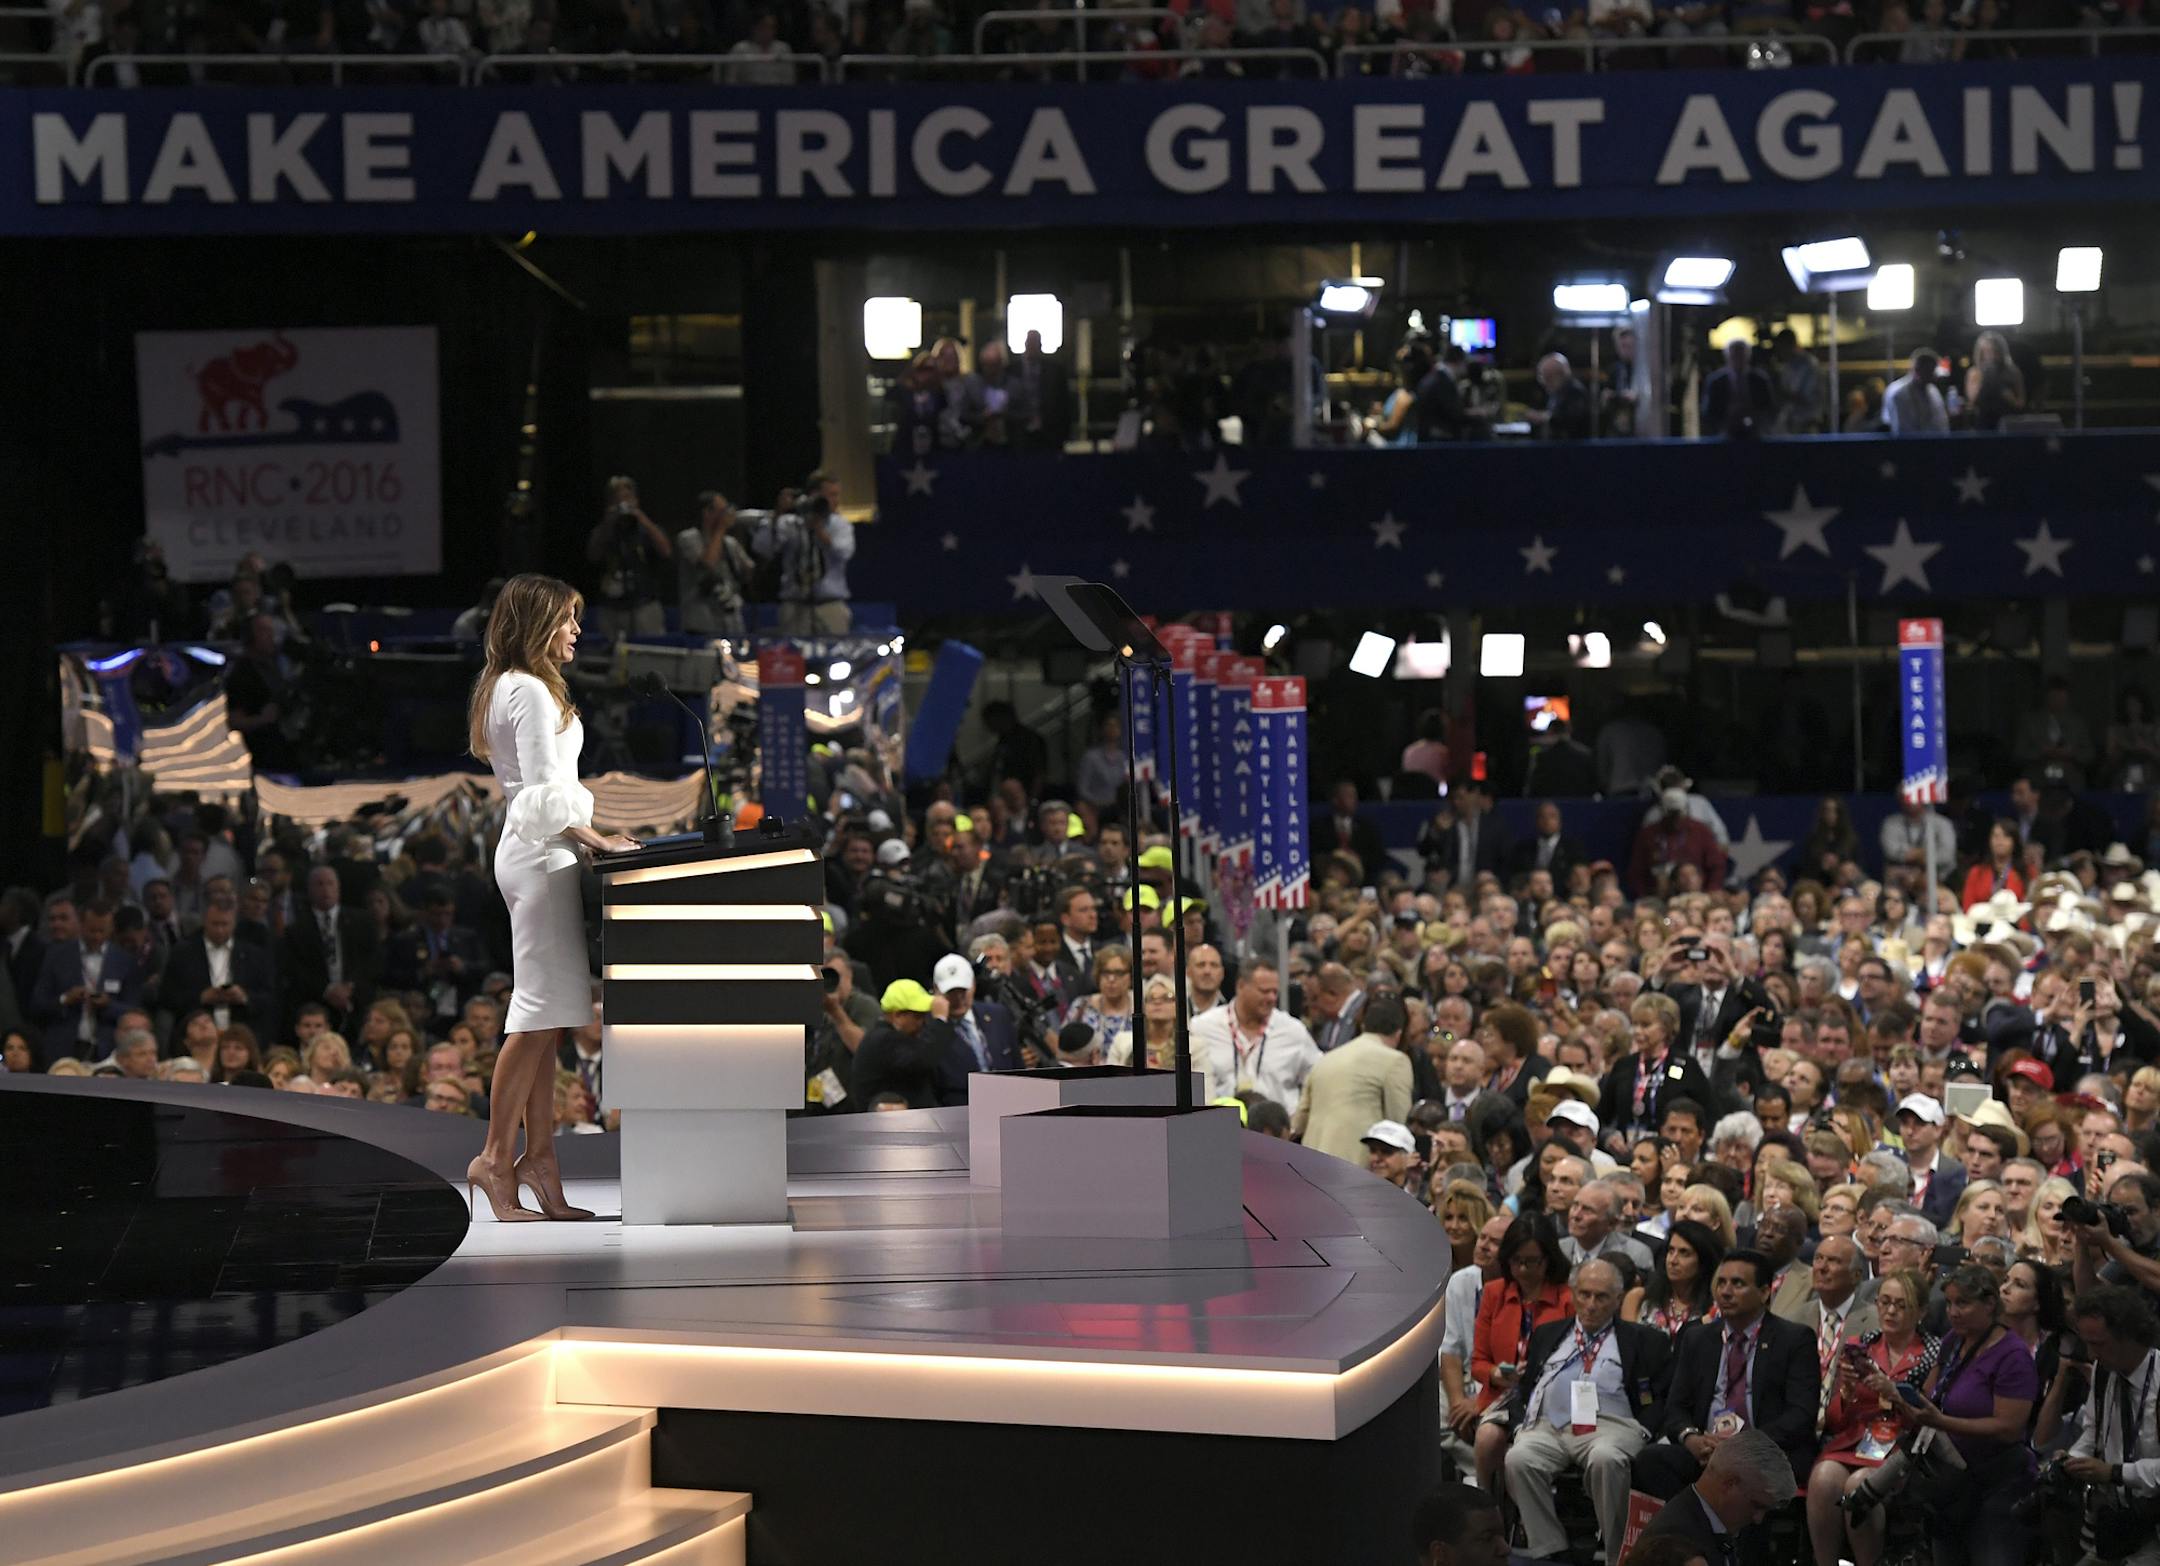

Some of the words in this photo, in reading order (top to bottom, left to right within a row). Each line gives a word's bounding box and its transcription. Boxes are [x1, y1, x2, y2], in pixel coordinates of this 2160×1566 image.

[32, 112, 416, 204] MAKE
[470, 107, 1096, 202] AMERICA
[1145, 99, 1606, 194] GREAT
[1656, 81, 2143, 184] AGAIN!
[185, 463, 284, 508] RNC
[304, 460, 403, 505] 2016
[187, 512, 404, 549] CLEVELAND
[1232, 697, 1254, 818] HAWAII
[1910, 657, 1926, 749] TEXAS
[1258, 715, 1273, 864] MARYLAND
[1285, 715, 1300, 864] MARYLAND
